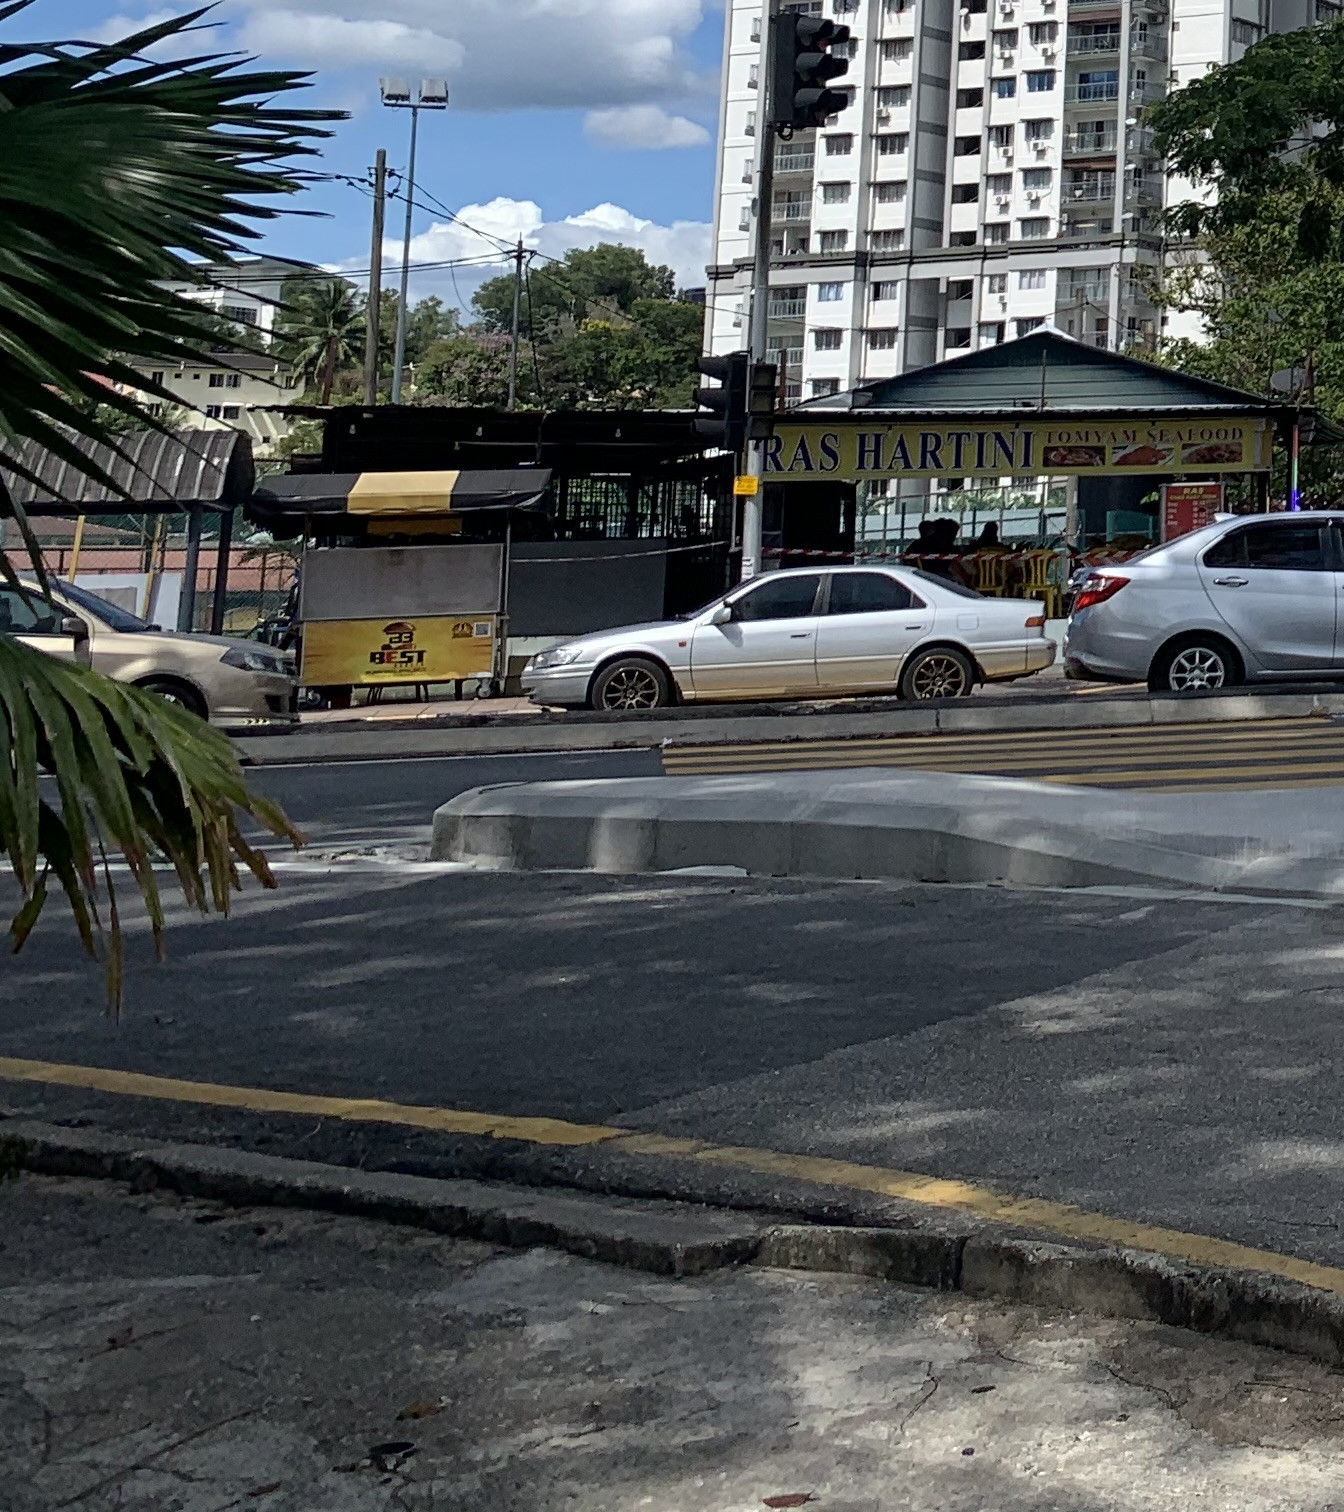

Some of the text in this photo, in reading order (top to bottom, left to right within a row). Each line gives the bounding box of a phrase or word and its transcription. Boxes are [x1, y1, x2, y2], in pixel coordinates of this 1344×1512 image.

[1046, 427, 1244, 444] TOMYAM SEAFOOD
[762, 430, 1035, 472] RAS HARTINI
[370, 650, 427, 664] BEST
